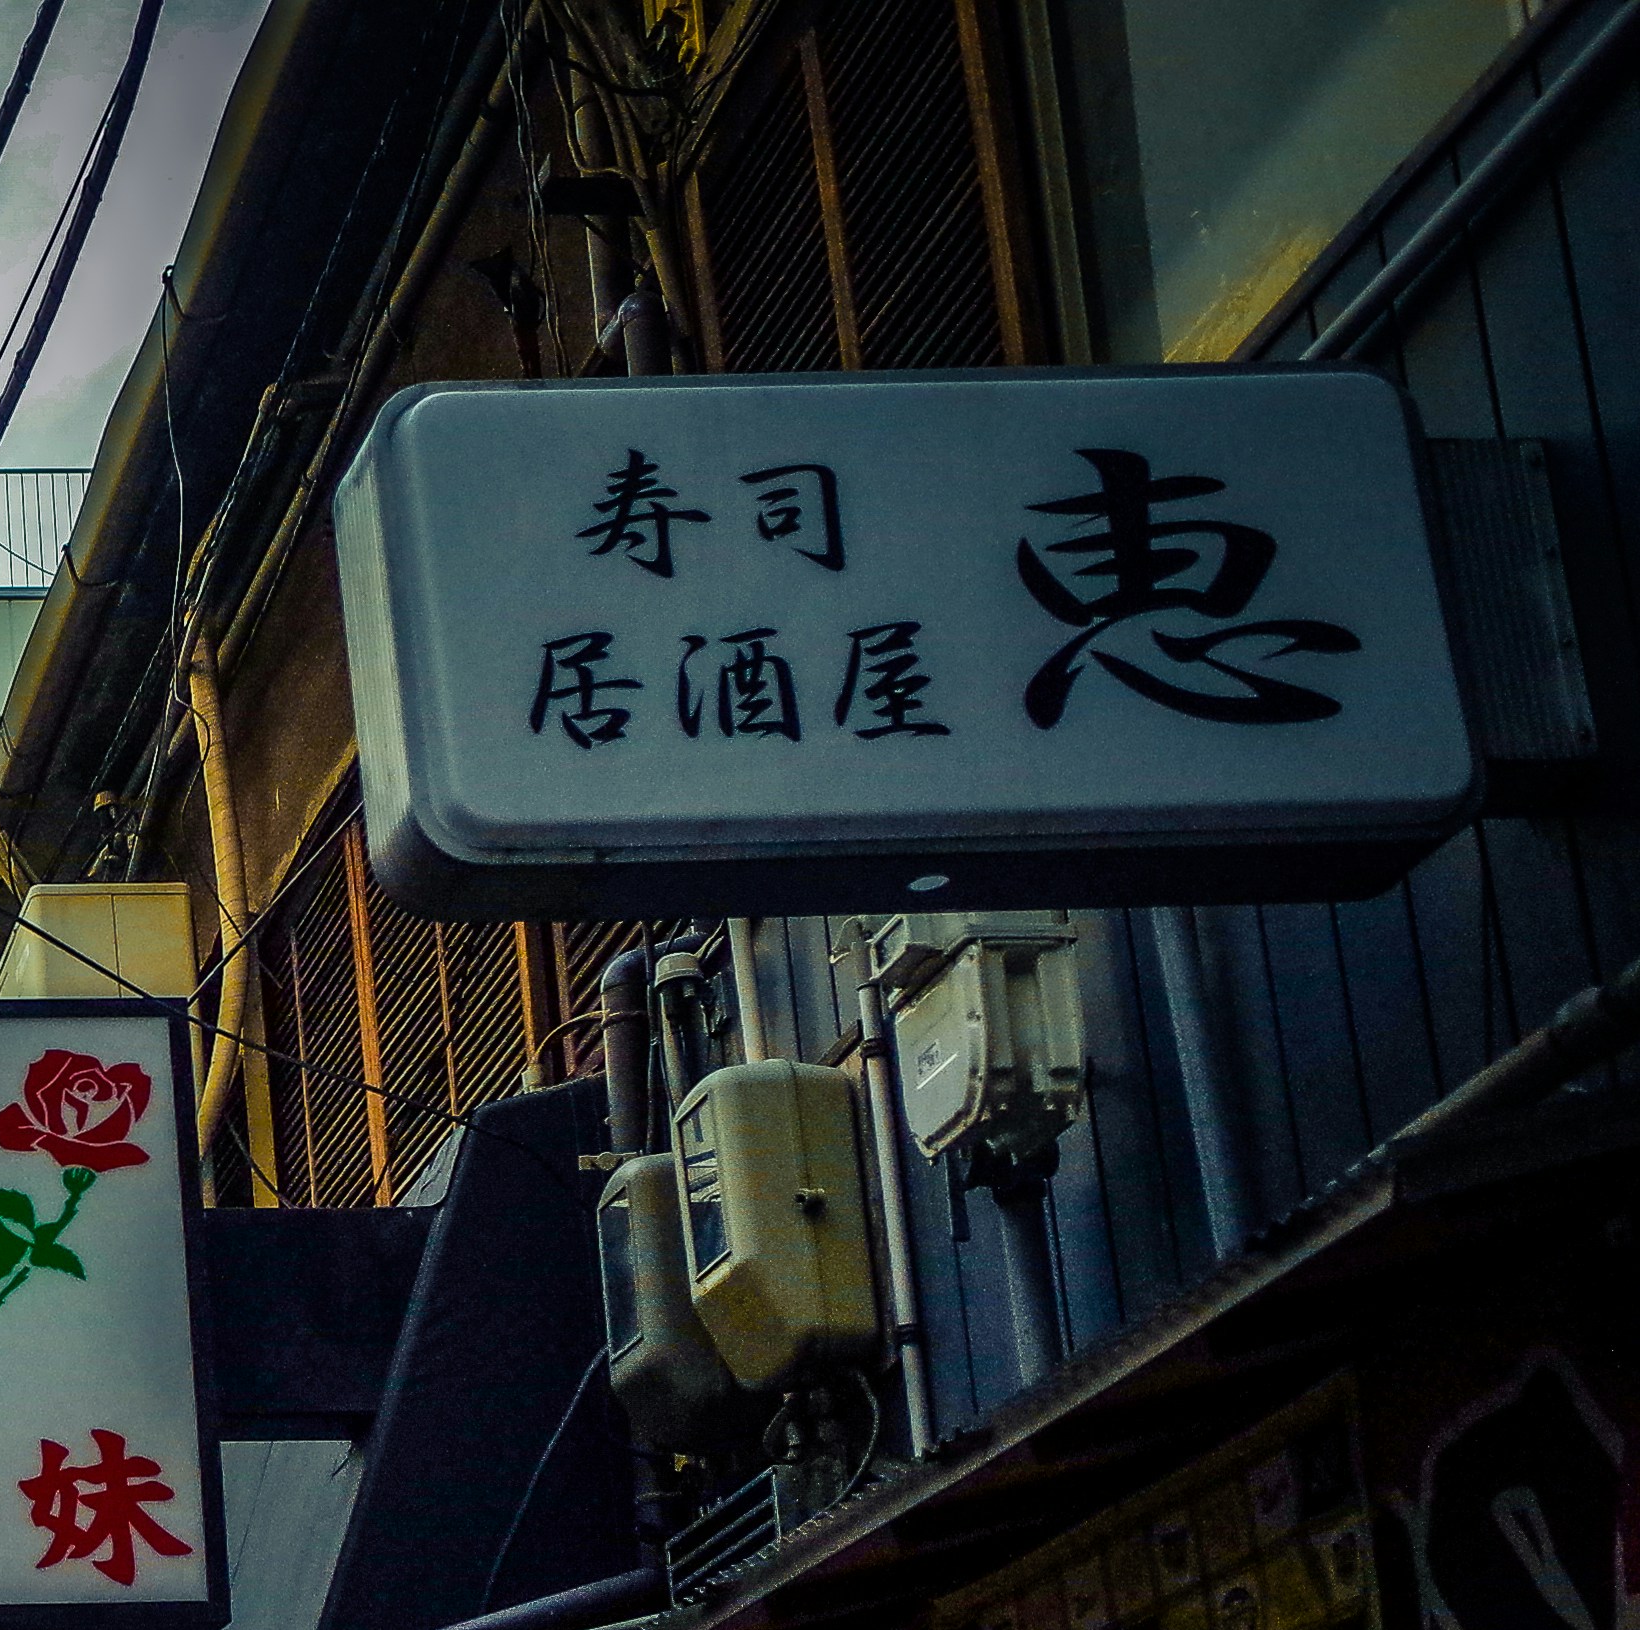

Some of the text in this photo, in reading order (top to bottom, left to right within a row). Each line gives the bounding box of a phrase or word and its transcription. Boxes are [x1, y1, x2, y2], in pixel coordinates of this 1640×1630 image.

[574, 448, 846, 579] 寿司
[1015, 448, 1363, 729] 恵
[528, 620, 951, 750] 居酒屋
